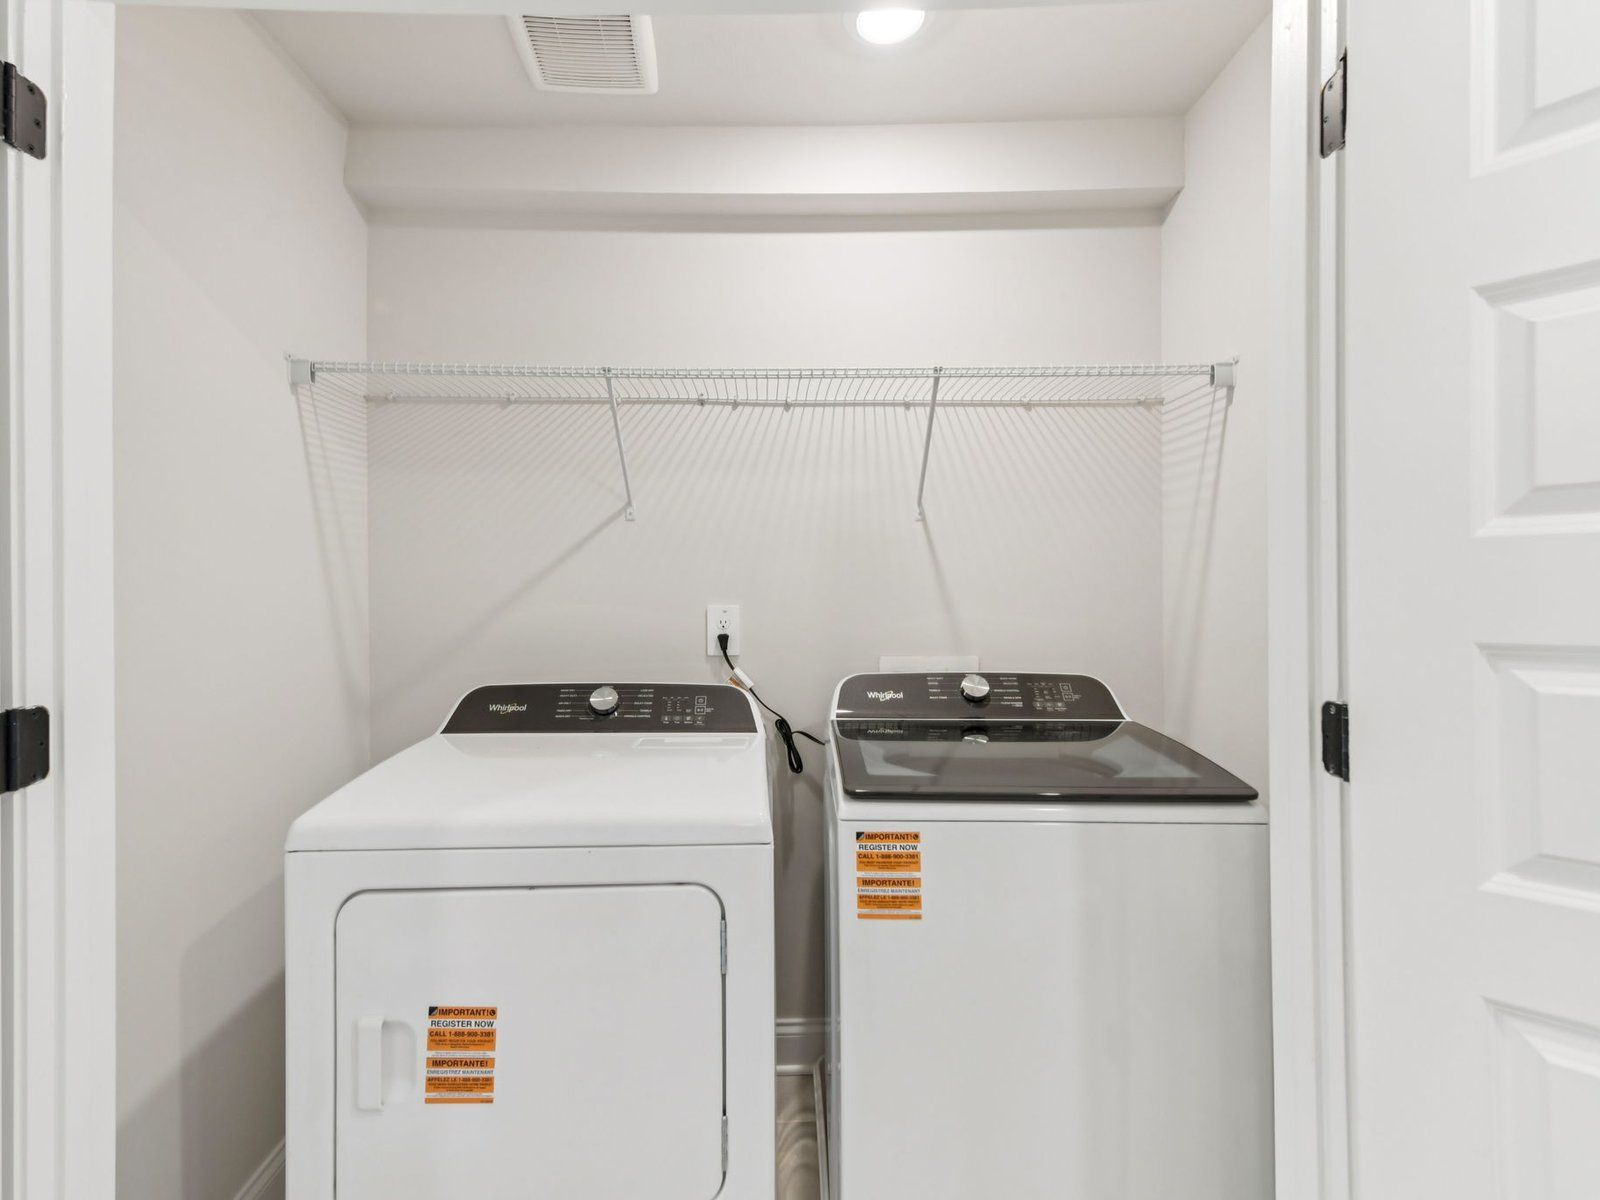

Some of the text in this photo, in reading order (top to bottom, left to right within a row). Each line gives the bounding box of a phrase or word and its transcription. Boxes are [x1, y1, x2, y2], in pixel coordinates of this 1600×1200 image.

[867, 691, 904, 702] Whirlpool
[489, 703, 527, 714] Whirlpool
[862, 879, 915, 887] IMPORTANTE!
[438, 1008, 489, 1016] IMPORTANT!
[430, 1020, 494, 1028] REGISTER NOW
[432, 1059, 488, 1067] IMPORTANTE!
